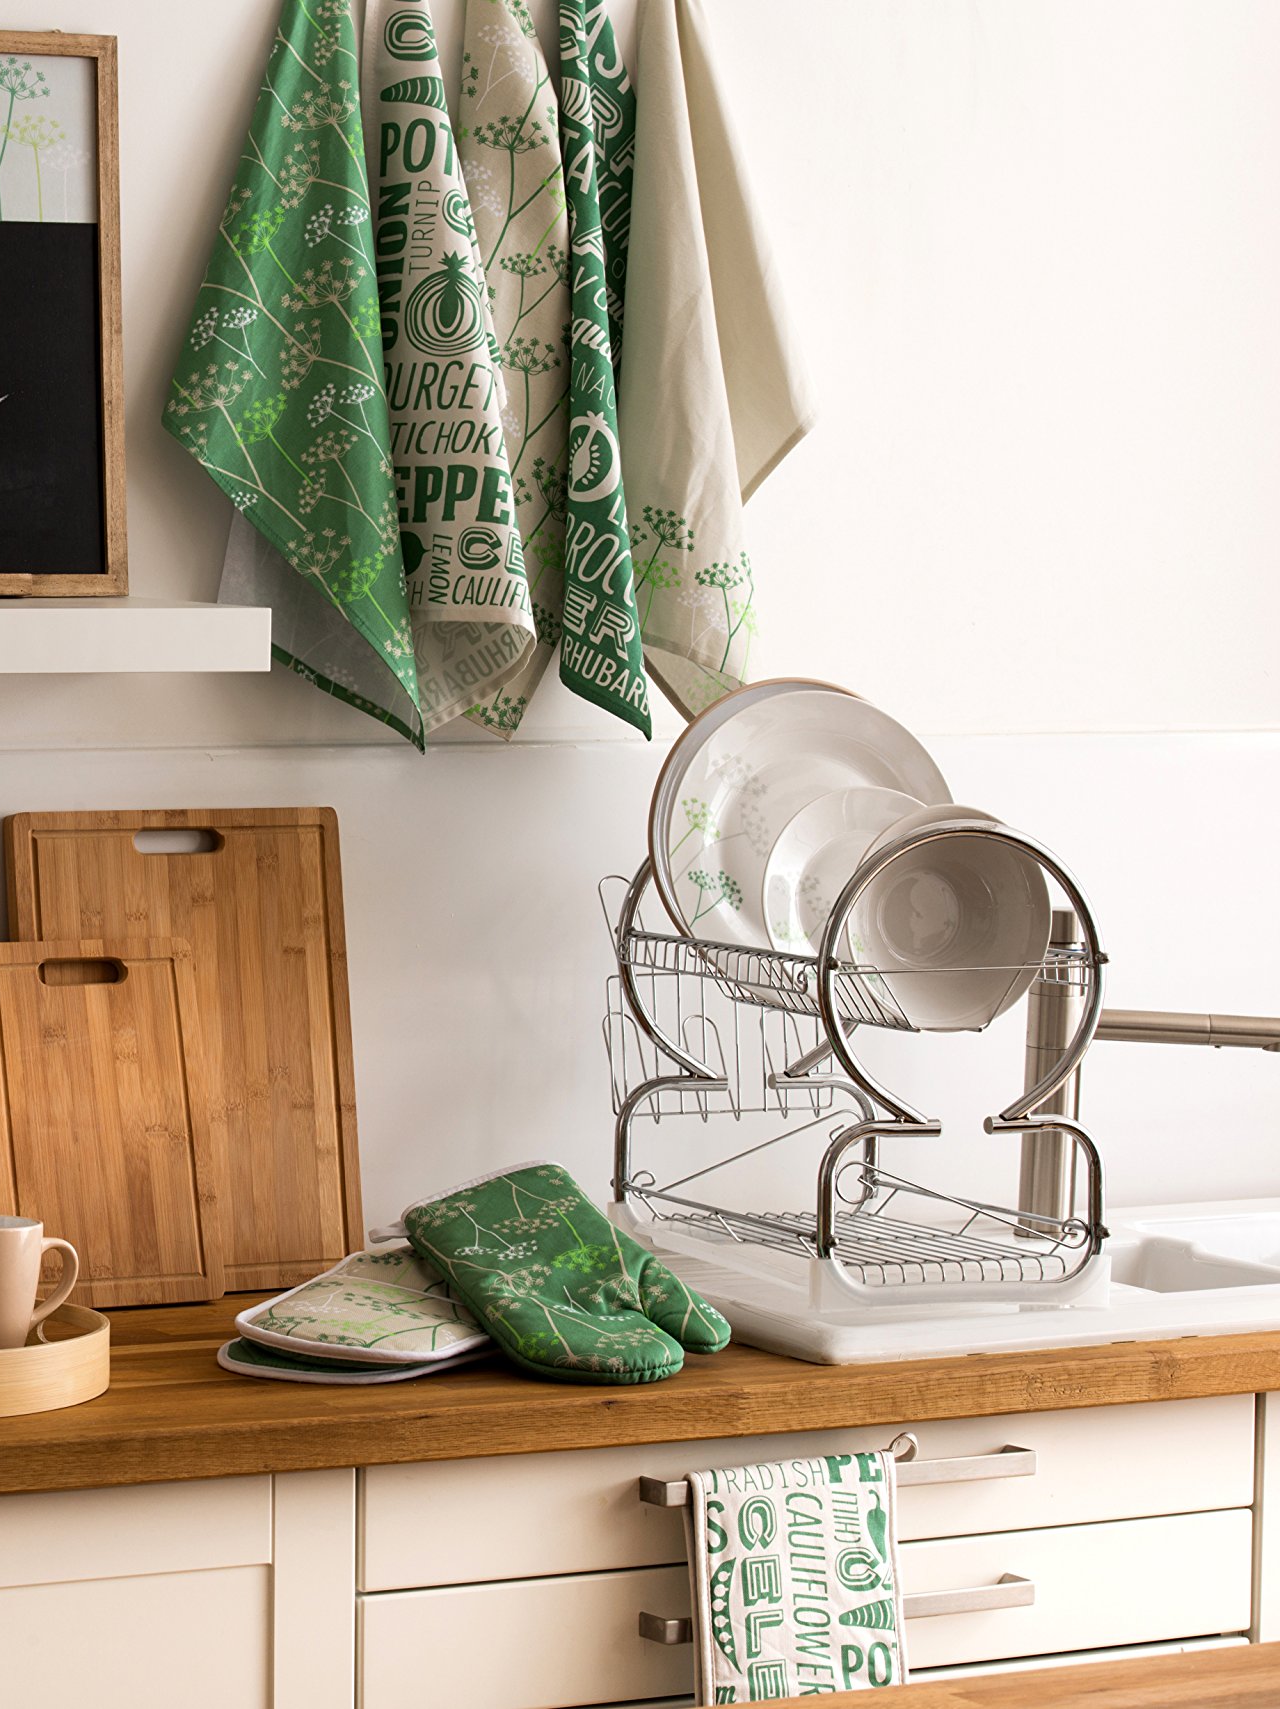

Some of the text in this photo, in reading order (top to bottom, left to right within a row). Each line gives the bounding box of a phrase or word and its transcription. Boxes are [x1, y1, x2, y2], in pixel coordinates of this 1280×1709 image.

[376, 181, 413, 352] ONION
[408, 179, 441, 276] TURNIP
[427, 532, 453, 606] LEMON
[721, 1459, 825, 1494] RADISH
[785, 1492, 837, 1697] CAULIFLOWER
